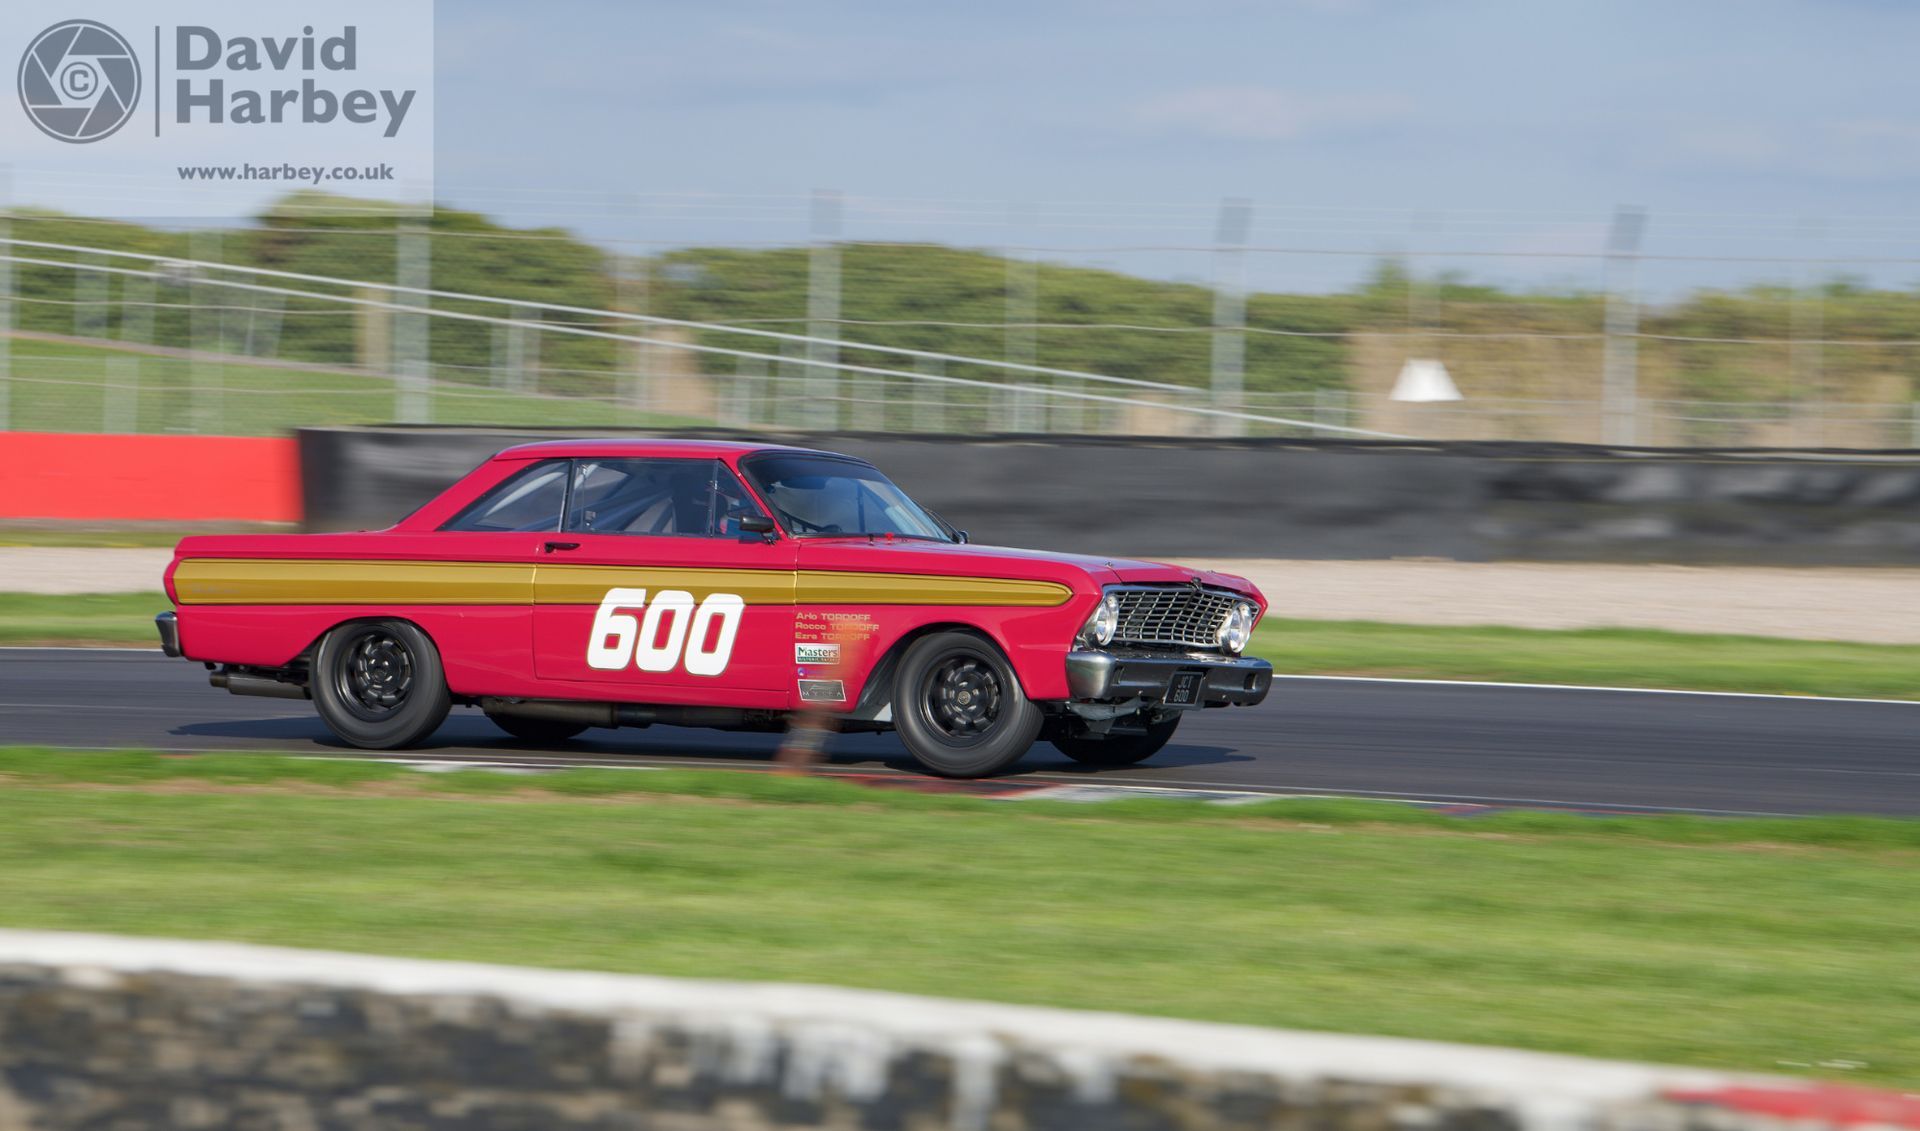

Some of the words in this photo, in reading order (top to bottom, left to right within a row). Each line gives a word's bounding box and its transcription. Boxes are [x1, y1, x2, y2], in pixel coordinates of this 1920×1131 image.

[796, 612, 818, 621] Arlo
[795, 622, 827, 630] Rocco
[586, 587, 746, 677] 600
[798, 646, 838, 657] Masters
[1173, 689, 1190, 702] 600
